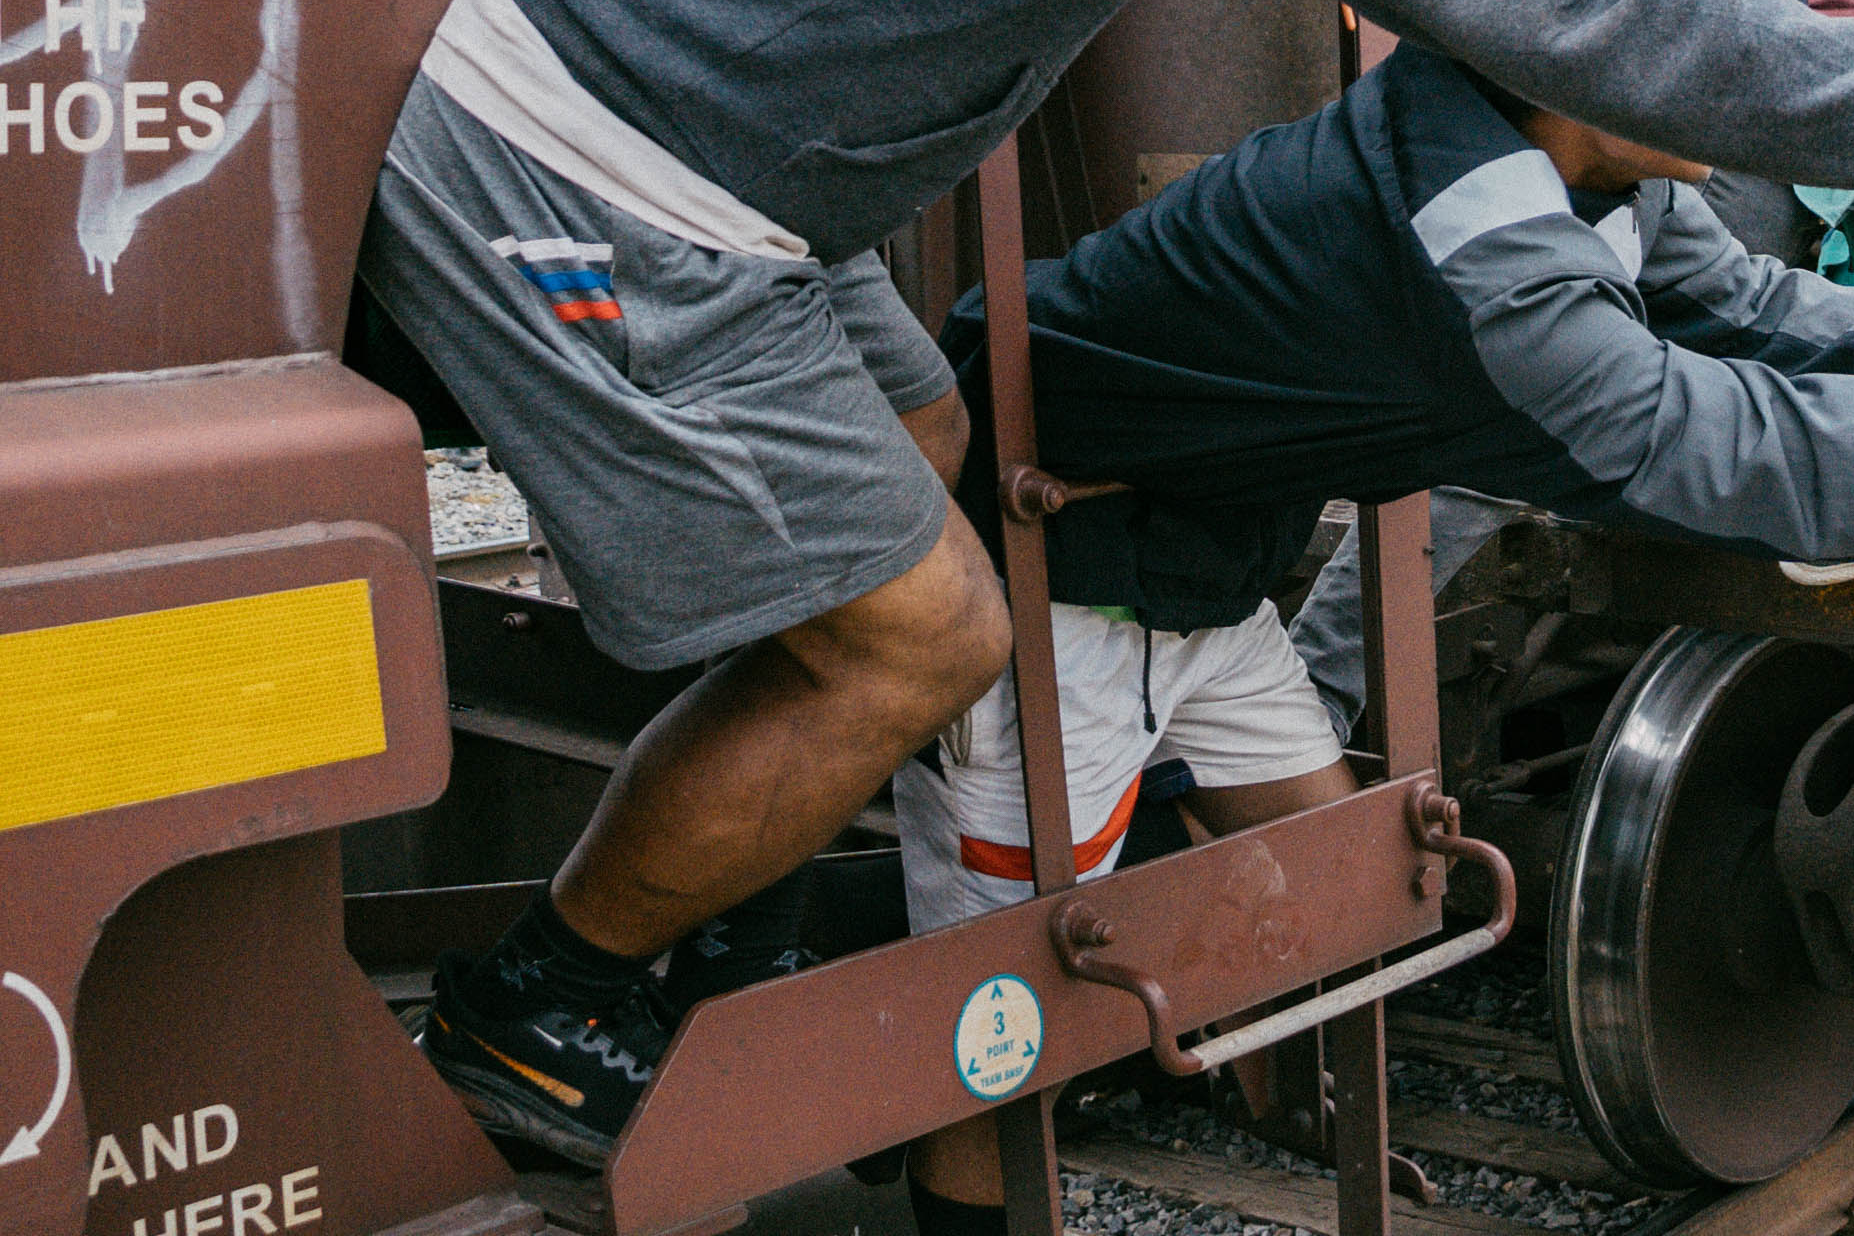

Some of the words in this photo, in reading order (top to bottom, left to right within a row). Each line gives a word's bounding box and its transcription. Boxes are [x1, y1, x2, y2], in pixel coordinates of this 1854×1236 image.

[0, 80, 225, 154] HOES
[994, 1011, 1005, 1035] 3
[987, 1039, 1015, 1059] POINT
[88, 1103, 239, 1196] AND
